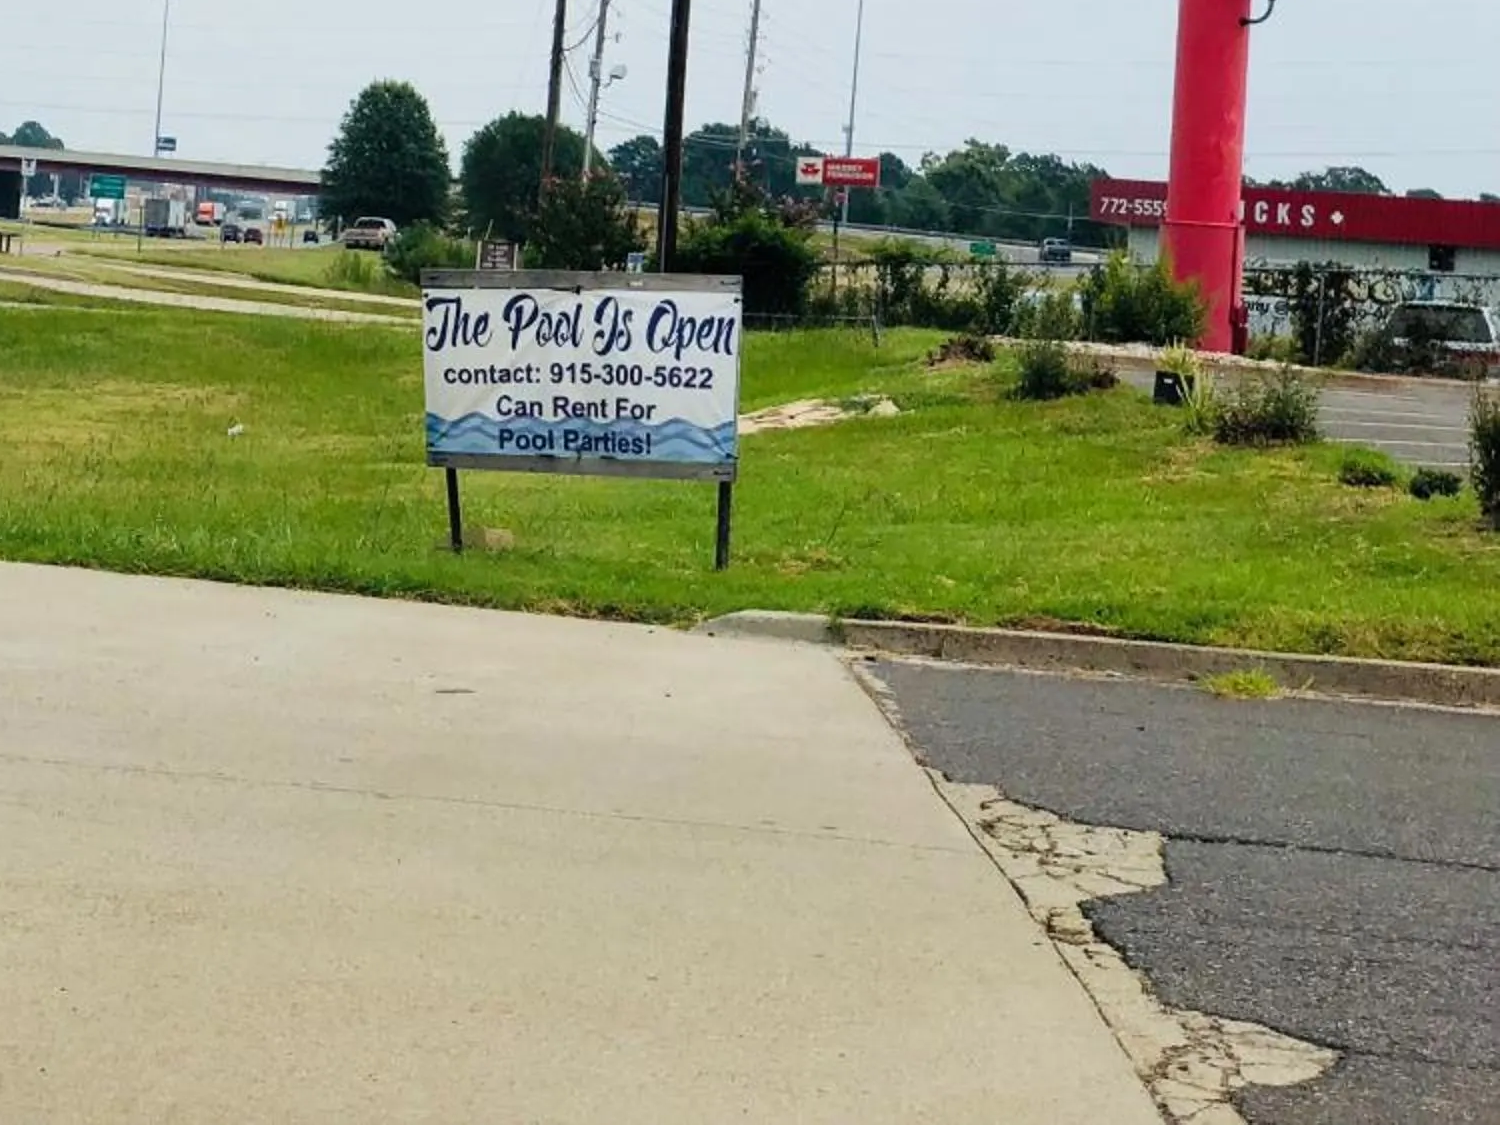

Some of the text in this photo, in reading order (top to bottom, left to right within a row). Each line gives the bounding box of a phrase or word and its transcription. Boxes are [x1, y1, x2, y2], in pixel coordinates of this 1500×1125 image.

[426, 293, 736, 360] The Pool Is Open
[443, 363, 713, 389] contact: 915-300-5622
[496, 395, 656, 420] Can Rent For
[499, 428, 651, 455] Pool Parties!
